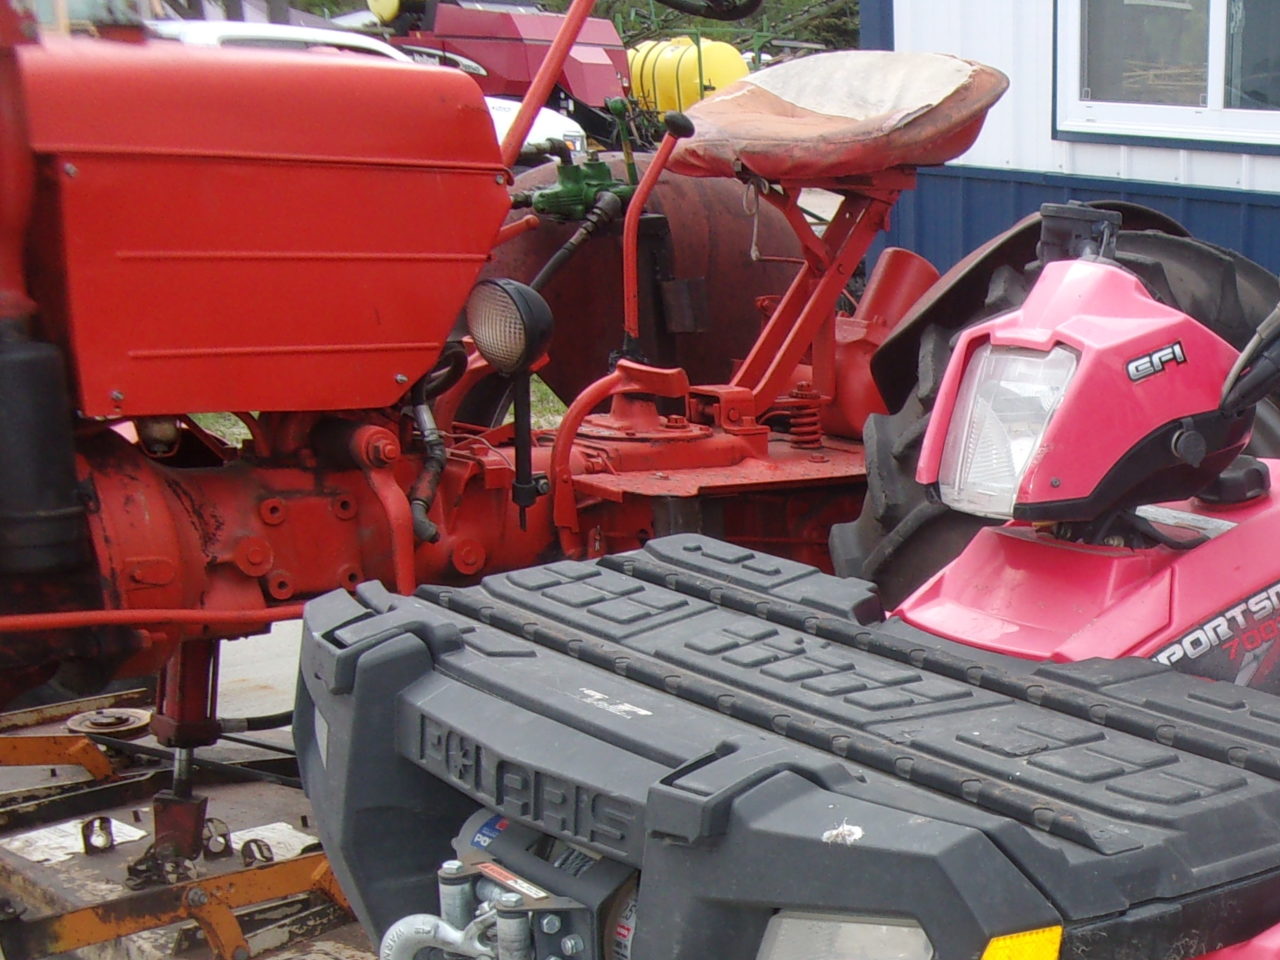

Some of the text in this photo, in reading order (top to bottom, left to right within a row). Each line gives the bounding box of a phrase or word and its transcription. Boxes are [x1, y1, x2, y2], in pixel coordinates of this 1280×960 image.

[1126, 341, 1187, 382] EFI
[1221, 619, 1278, 660] 700
[419, 713, 635, 857] POLARIS
[383, 927, 405, 960] WARN
